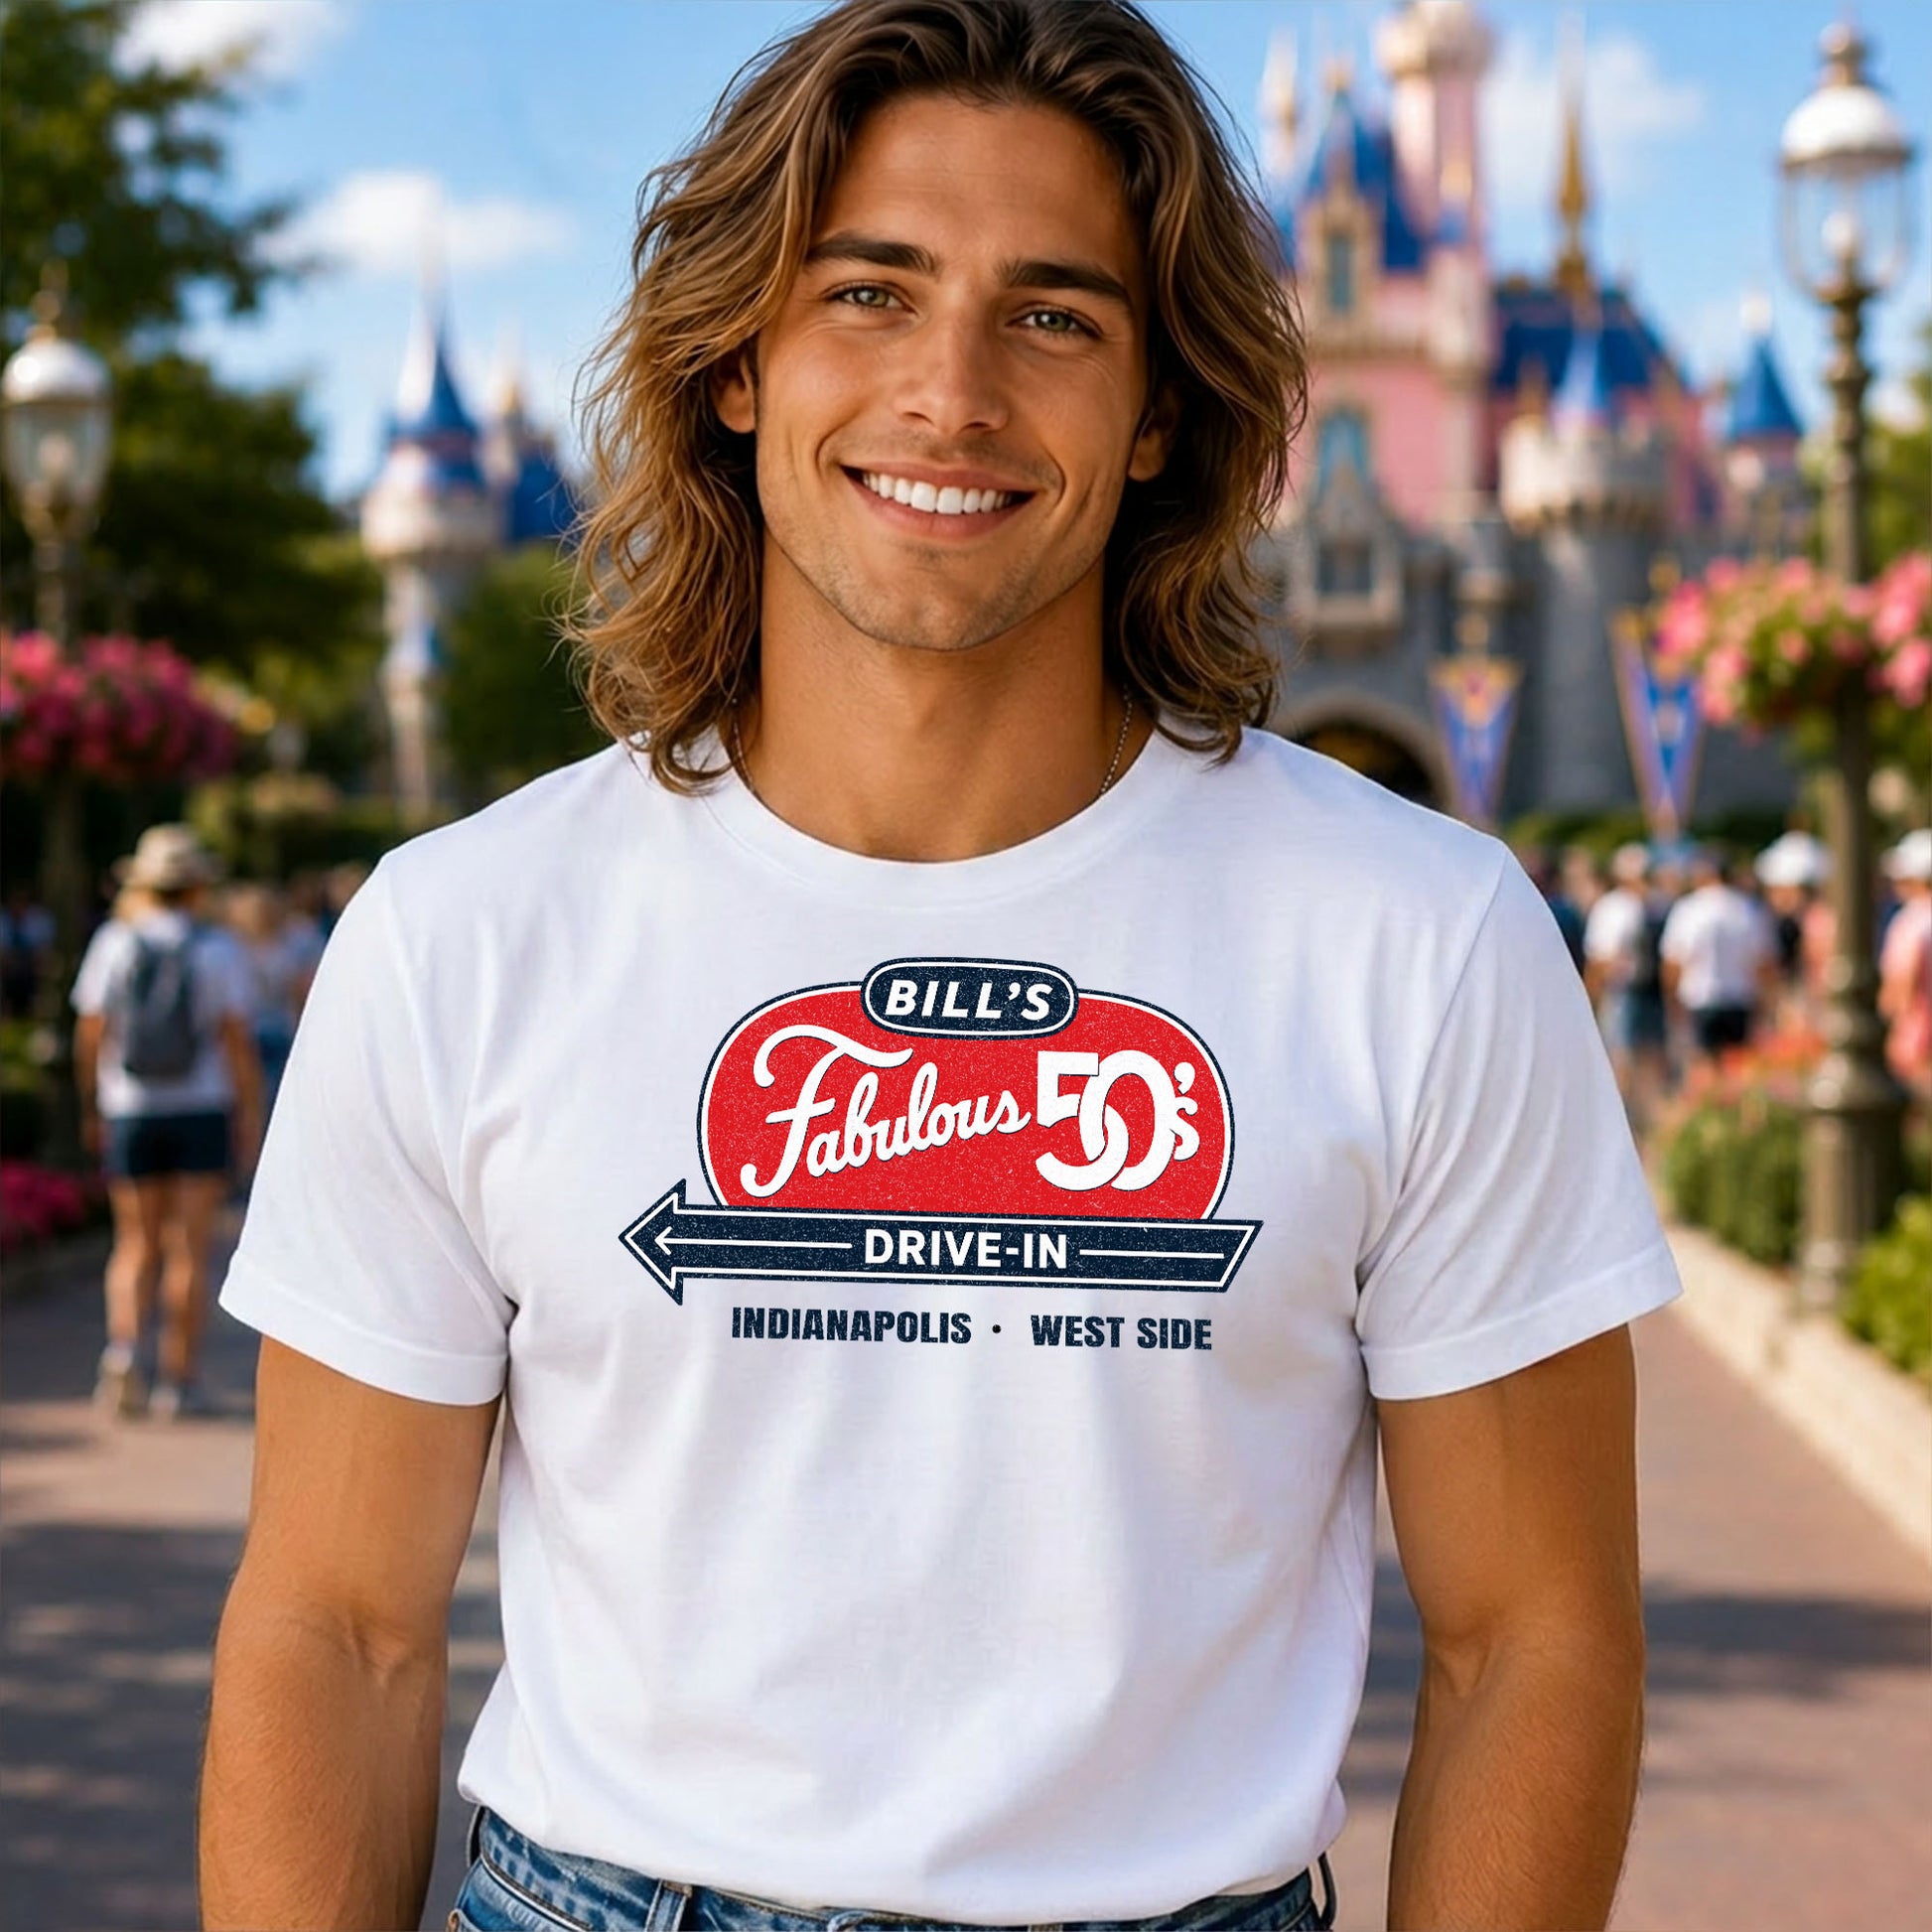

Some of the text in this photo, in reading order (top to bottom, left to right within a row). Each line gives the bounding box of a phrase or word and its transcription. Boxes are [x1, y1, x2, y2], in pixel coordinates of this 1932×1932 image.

[884, 978, 1053, 1021] BILL'S
[740, 1024, 1201, 1199] Fabulous 50's
[864, 1228, 1068, 1271] DRIVE-IN
[731, 1306, 1213, 1351] INDIANAPOLIS WEST SIDE
